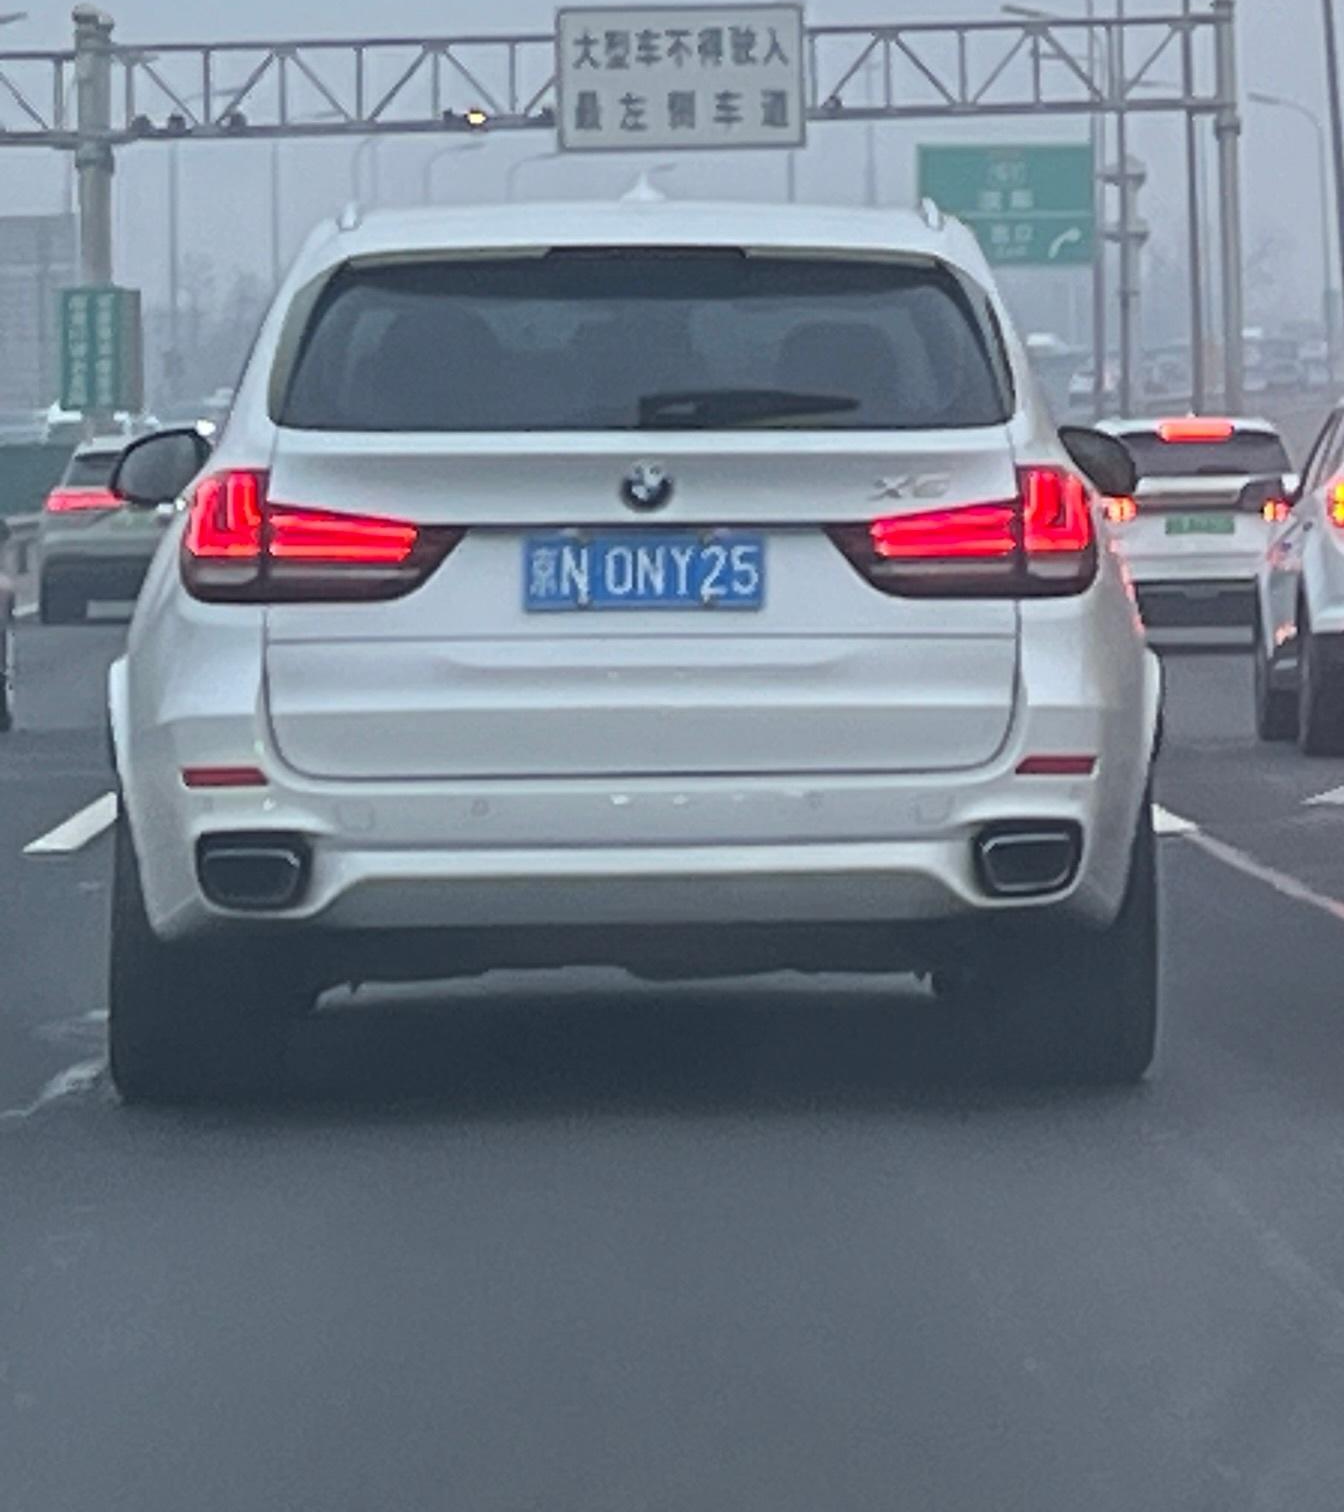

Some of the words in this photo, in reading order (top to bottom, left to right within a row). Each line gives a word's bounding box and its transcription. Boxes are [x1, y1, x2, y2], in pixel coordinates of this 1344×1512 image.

[572, 26, 789, 70] 大型车不得驶入
